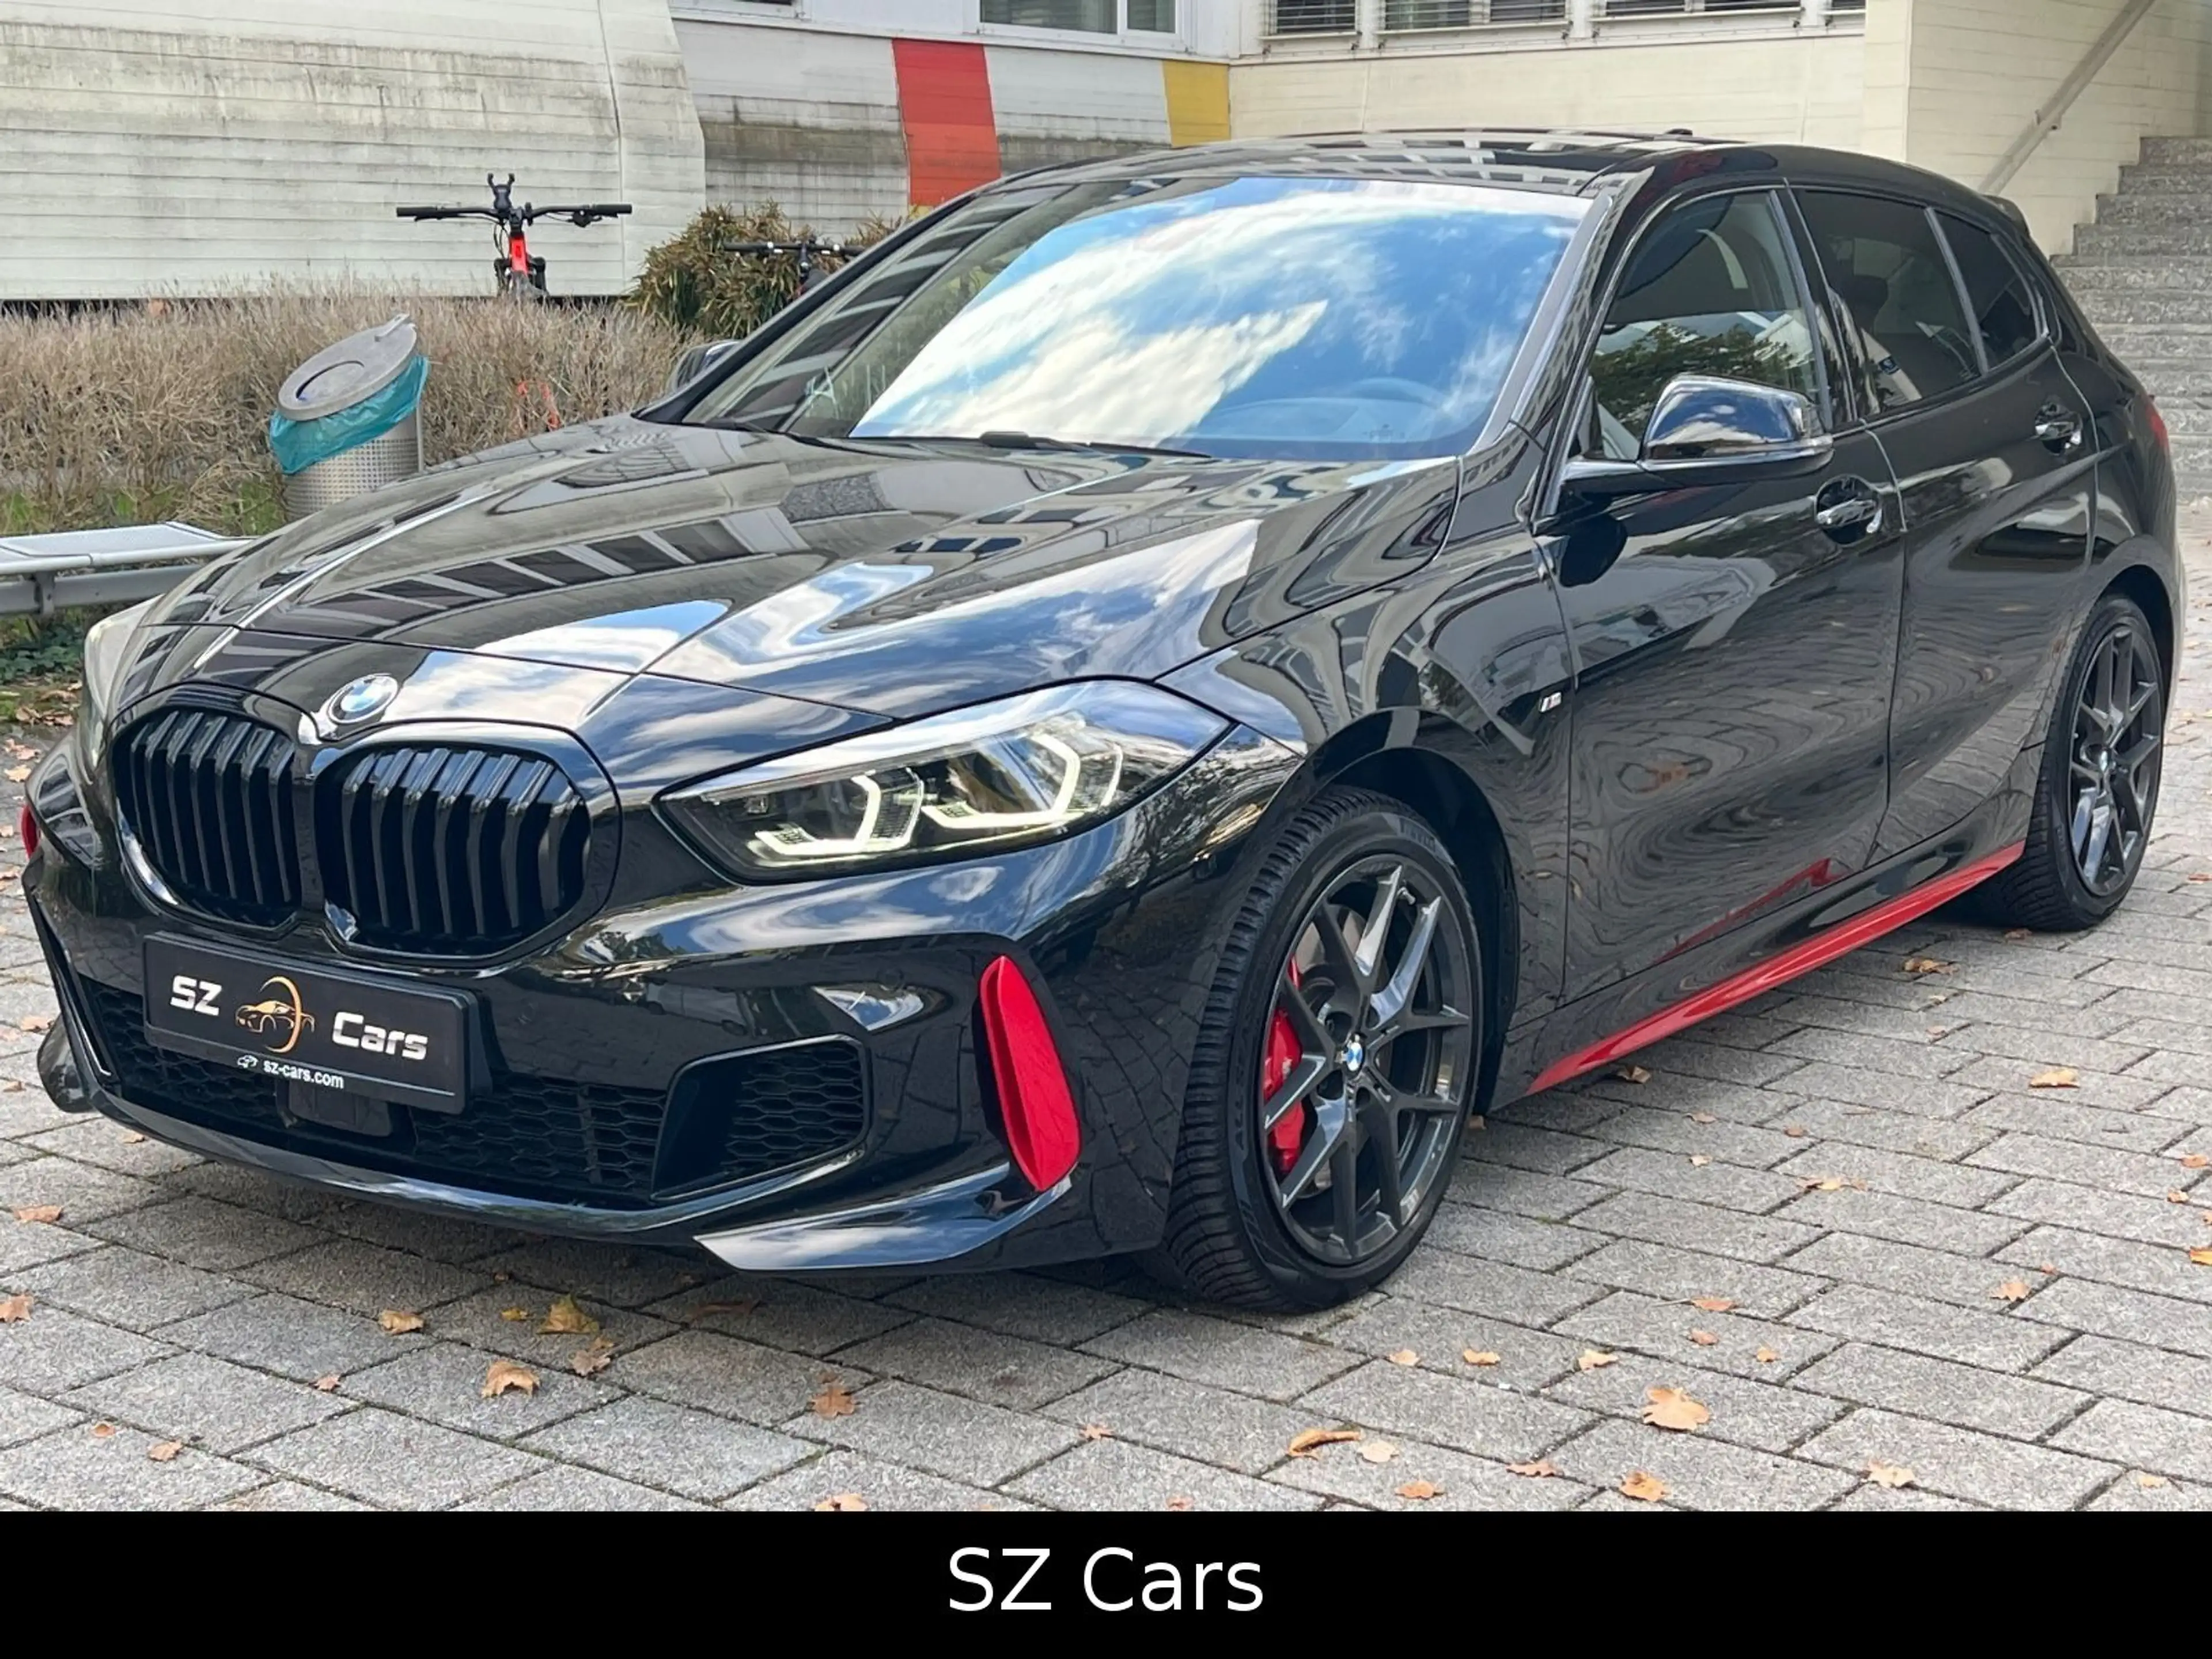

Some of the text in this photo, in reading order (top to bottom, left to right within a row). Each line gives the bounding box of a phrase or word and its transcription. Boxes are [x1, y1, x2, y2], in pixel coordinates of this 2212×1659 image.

[170, 975, 429, 1060] SZ Cars
[263, 1060, 344, 1089] sz-cars.com
